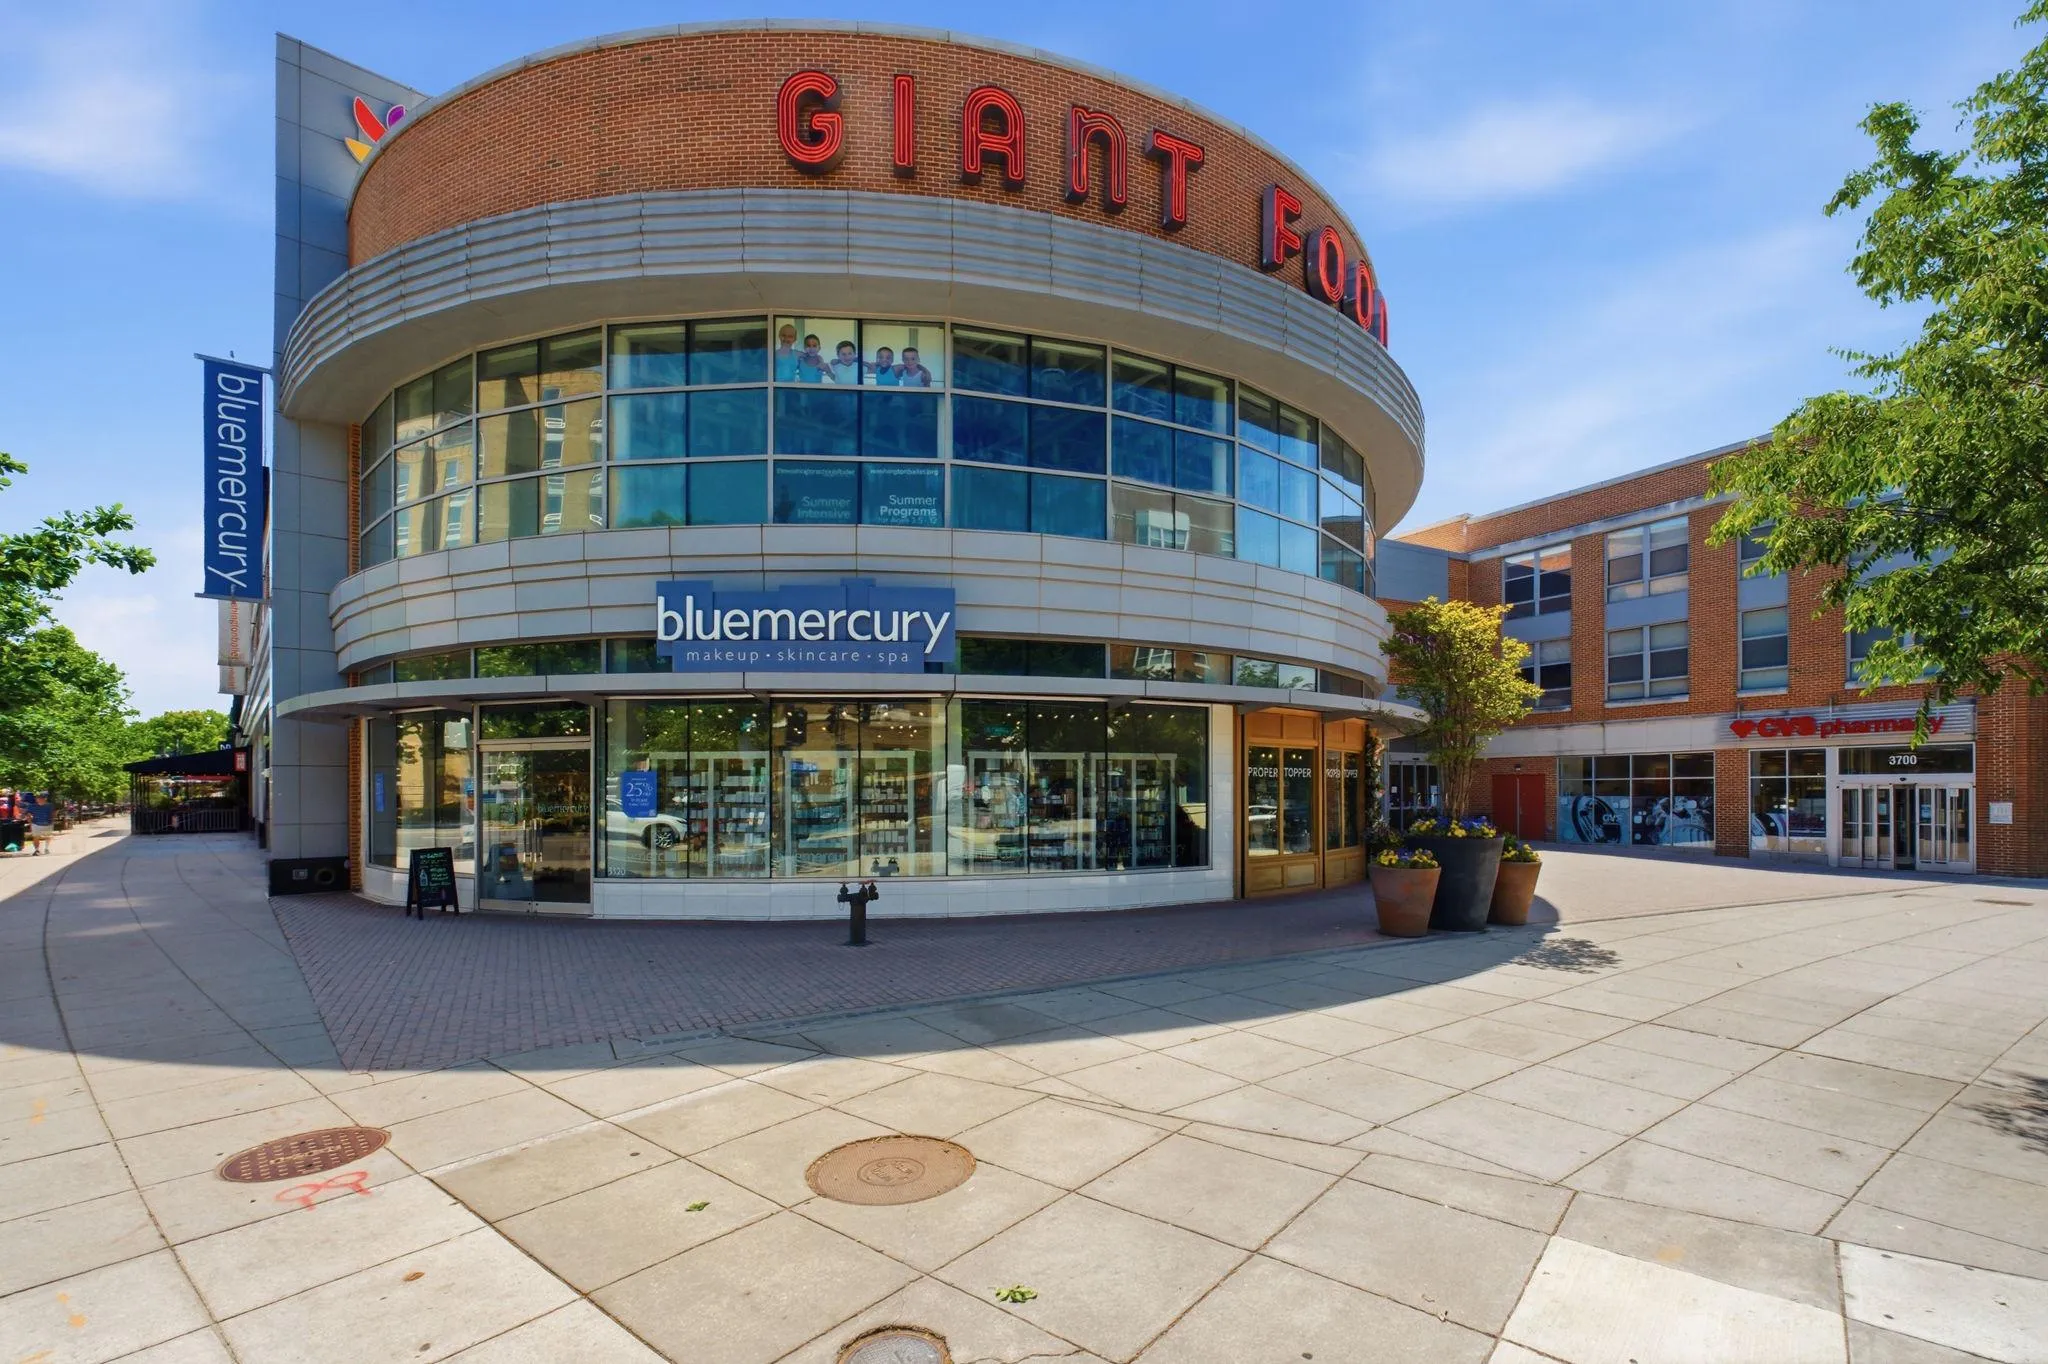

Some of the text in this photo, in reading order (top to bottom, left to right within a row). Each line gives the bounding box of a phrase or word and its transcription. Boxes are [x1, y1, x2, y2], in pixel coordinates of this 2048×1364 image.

[207, 372, 260, 588] bluemercury
[802, 496, 852, 507] Summer
[889, 495, 937, 505] Summer
[880, 505, 938, 518] Programs
[657, 595, 951, 654] bluemercury
[686, 648, 909, 665] makeup skincare spa
[1757, 715, 1945, 739] CVS pharmay
[1888, 755, 1917, 766] 3700
[1248, 767, 1312, 778] PROPER TOPPER
